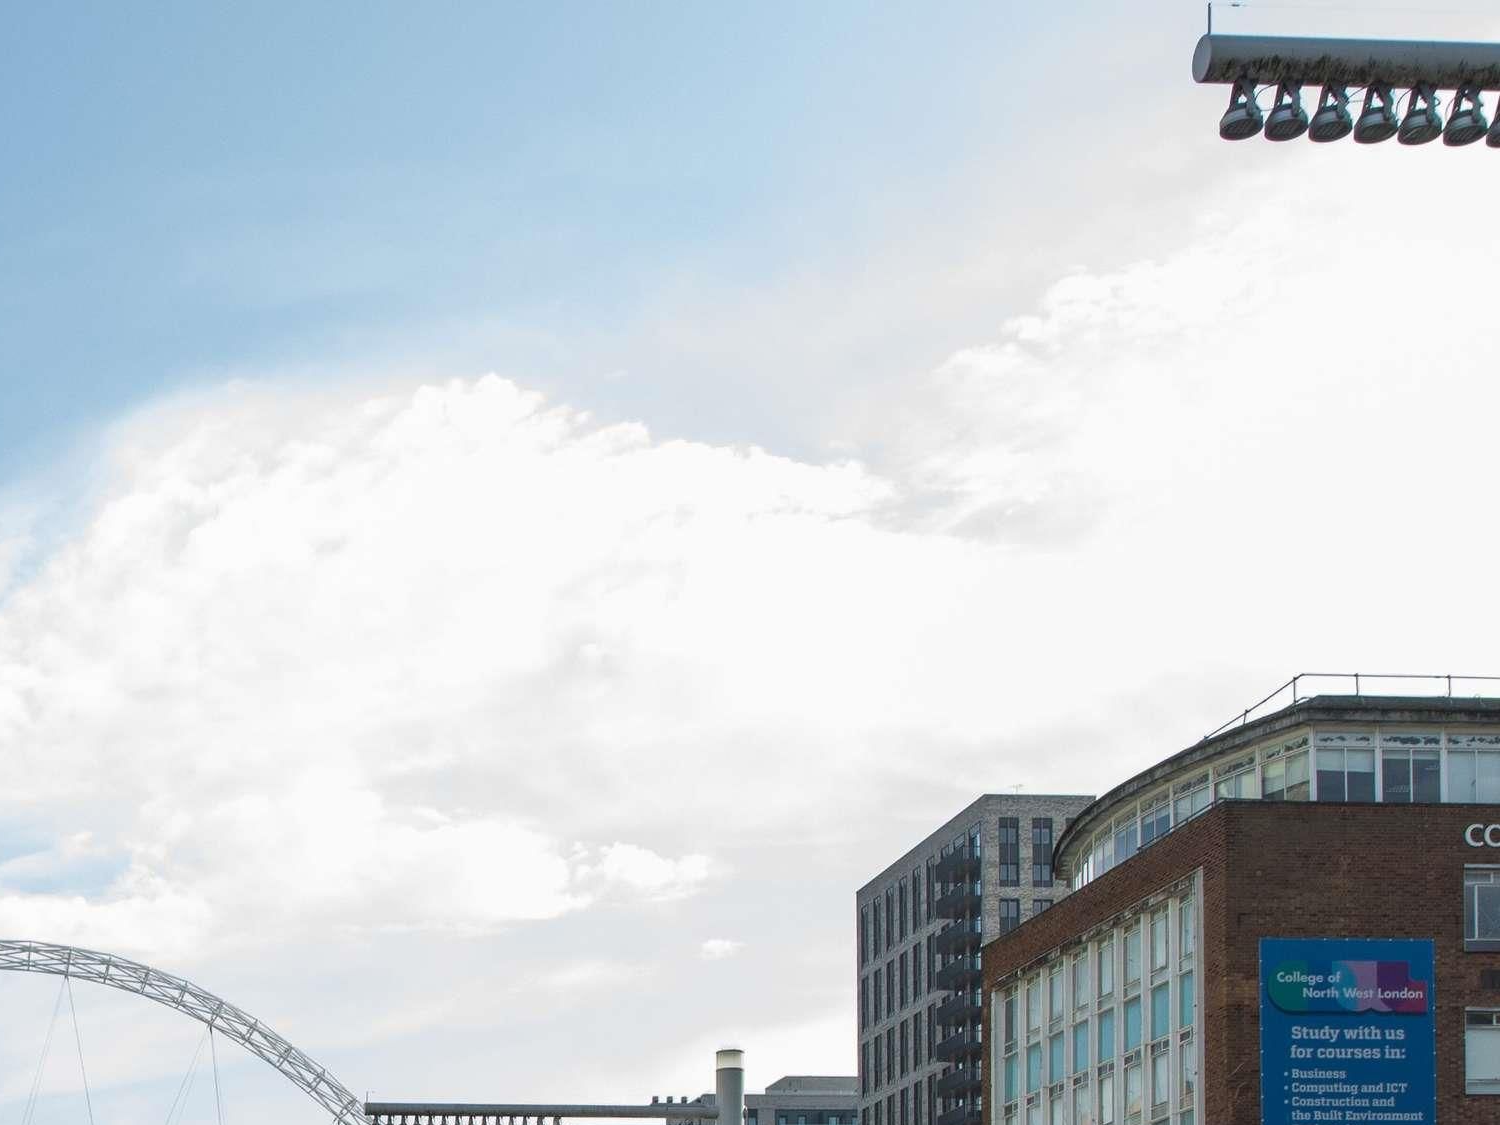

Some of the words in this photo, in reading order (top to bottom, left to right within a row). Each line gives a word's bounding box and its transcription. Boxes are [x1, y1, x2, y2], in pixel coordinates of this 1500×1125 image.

[1276, 971, 1323, 985] College
[1328, 971, 1341, 983] of
[1302, 987, 1339, 998] North
[1343, 987, 1374, 998] West
[1377, 987, 1424, 999] London
[1291, 1025, 1340, 1042] Study
[1344, 1026, 1381, 1040] with
[1385, 1029, 1405, 1040] us
[1290, 1044, 1312, 1058] for
[1317, 1047, 1381, 1059] courses
[1384, 1045, 1406, 1059] in:
[1291, 1068, 1347, 1079] Business
[1291, 1082, 1358, 1095] Computing
[1361, 1082, 1383, 1093] and
[1386, 1082, 1408, 1093] ICT
[1291, 1096, 1370, 1107] Construction
[1372, 1096, 1395, 1107] and
[1291, 1110, 1311, 1120] the
[1313, 1110, 1342, 1120] Built
[1345, 1110, 1424, 1121] Environment
